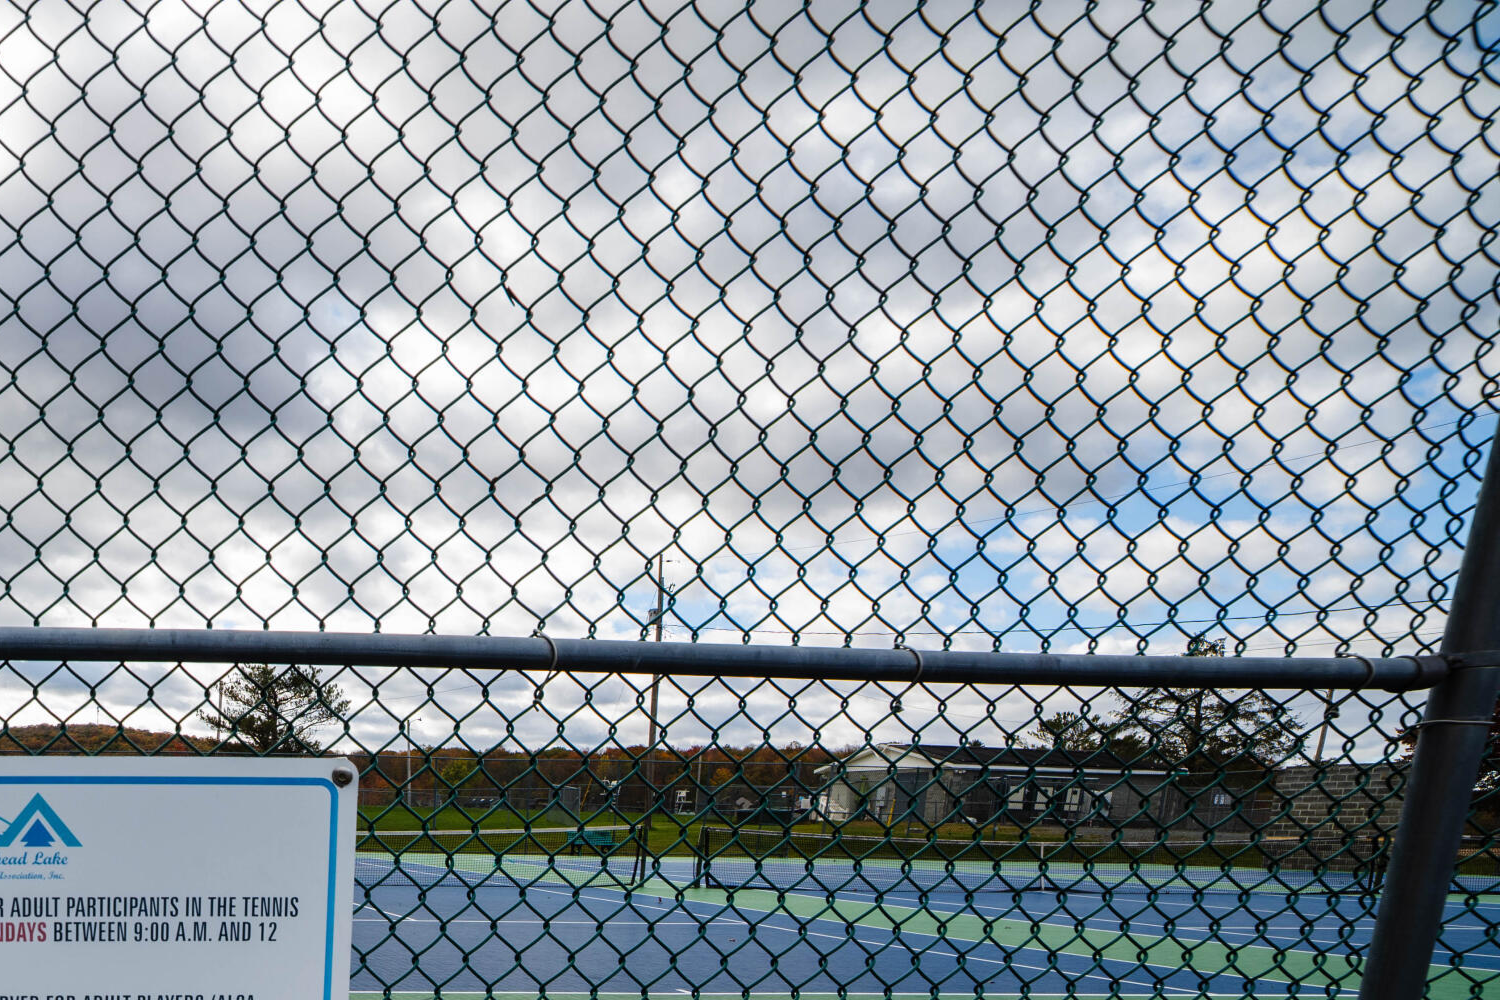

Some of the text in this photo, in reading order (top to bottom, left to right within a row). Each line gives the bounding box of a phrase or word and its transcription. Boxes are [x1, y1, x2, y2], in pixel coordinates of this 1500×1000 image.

[32, 851, 68, 866] Lake
[48, 871, 65, 880] Inc.
[10, 896, 60, 917] ADULT
[66, 896, 178, 917] PARTICIPANTS
[185, 896, 201, 917] IN
[208, 896, 236, 917] THE
[242, 896, 298, 917] TENNIS
[53, 921, 126, 942] BETWEEN
[134, 921, 169, 942] 9:00
[175, 921, 211, 941] A.M.
[218, 921, 251, 941] AND
[259, 921, 277, 941] 12
